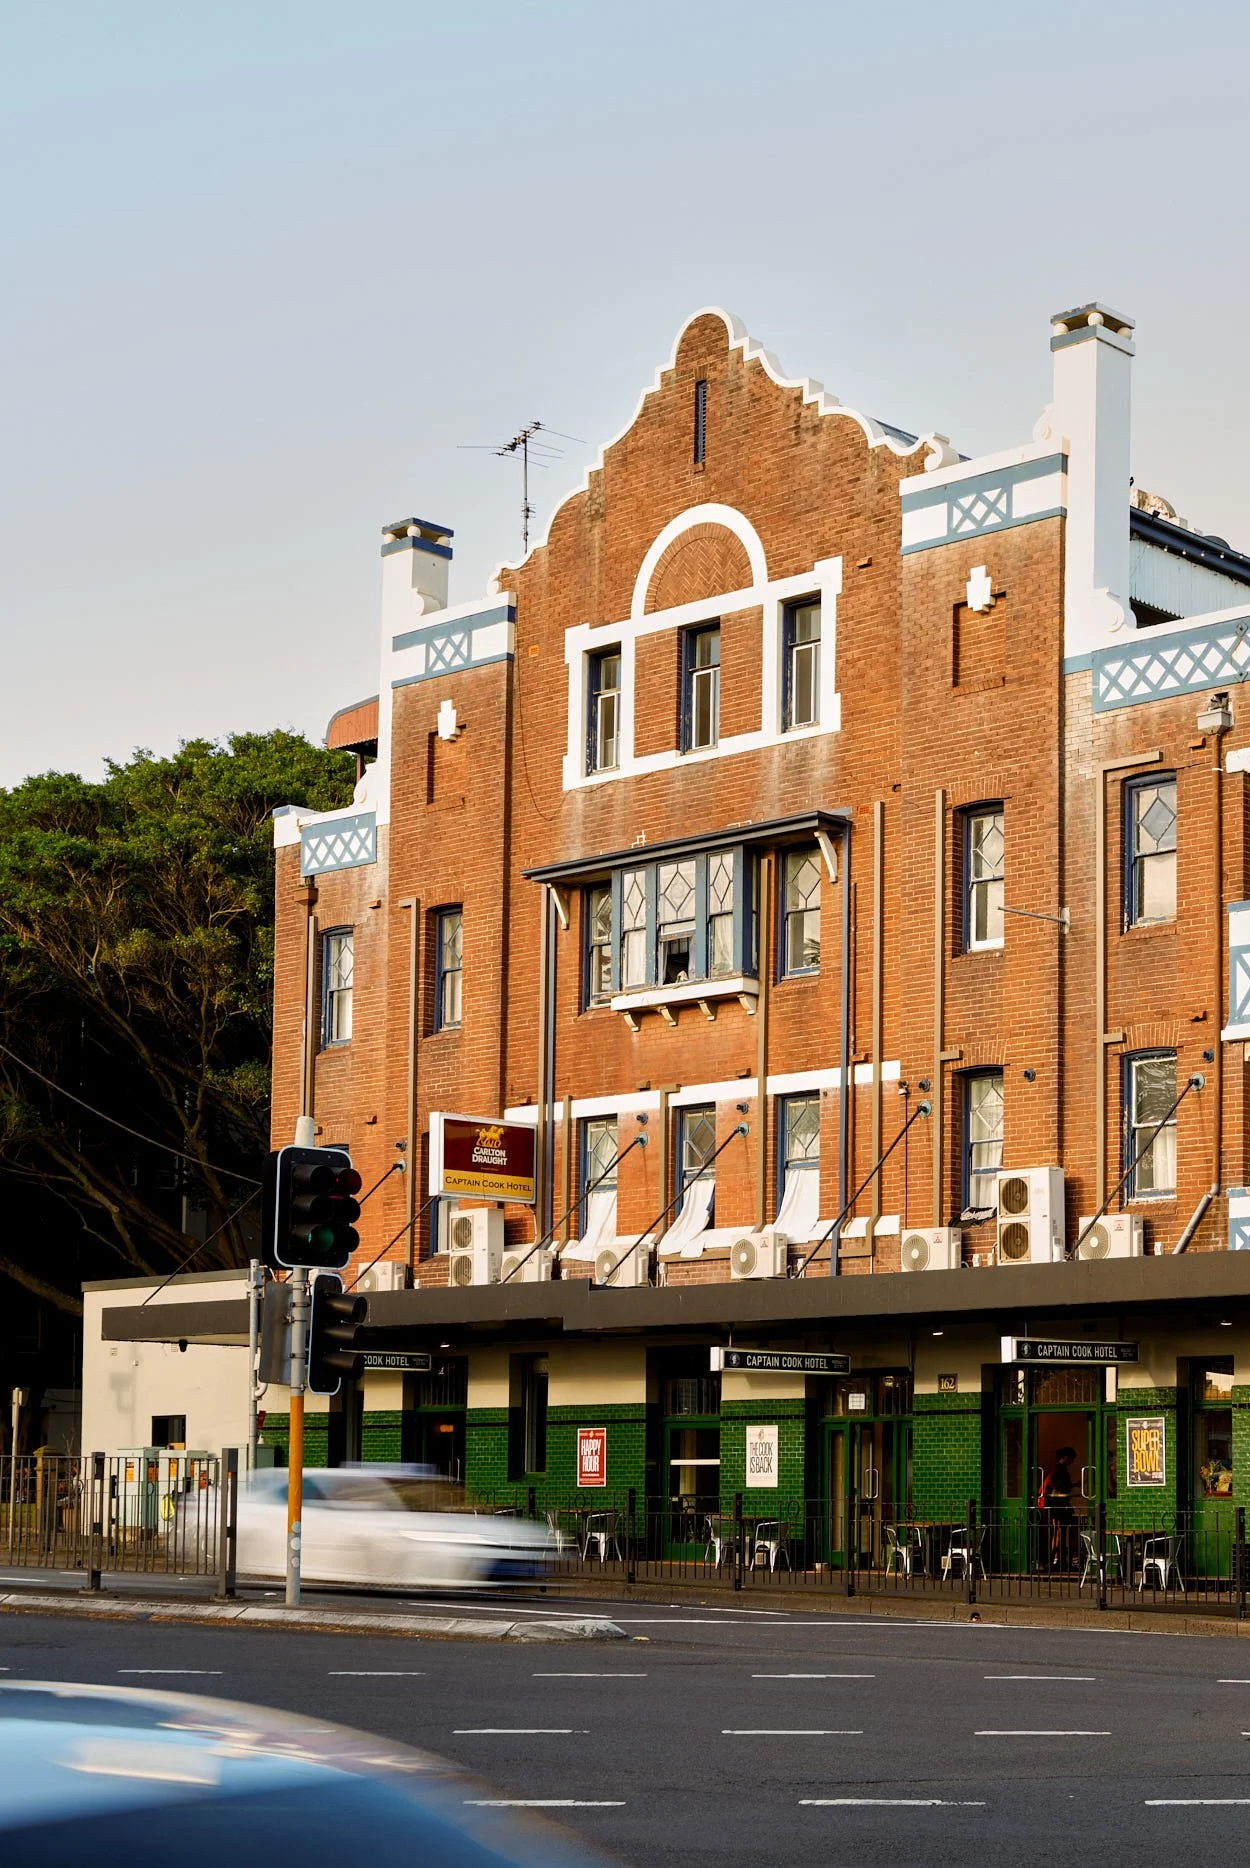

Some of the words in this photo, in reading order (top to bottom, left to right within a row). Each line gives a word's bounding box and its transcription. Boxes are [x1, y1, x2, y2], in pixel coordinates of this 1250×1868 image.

[473, 1146, 506, 1157] CARLTON
[471, 1153, 508, 1166] DRAUGHT
[1037, 1344, 1070, 1358] CAPTAIN
[1072, 1345, 1092, 1358] COOK
[1094, 1346, 1118, 1358] HOTEL
[385, 1356, 410, 1367] HOTEL
[746, 1355, 780, 1367] CAPTAIN
[781, 1356, 803, 1368] COOK
[804, 1358, 829, 1370] HOTEL
[940, 1377, 955, 1390] 162
[581, 1438, 602, 1456] HAPPY
[1131, 1429, 1160, 1451] SUPER
[749, 1441, 758, 1457] THE
[758, 1441, 773, 1457] COOK
[582, 1455, 600, 1473] HOUR
[755, 1456, 773, 1473] BACK
[1133, 1450, 1161, 1473] BOWL
